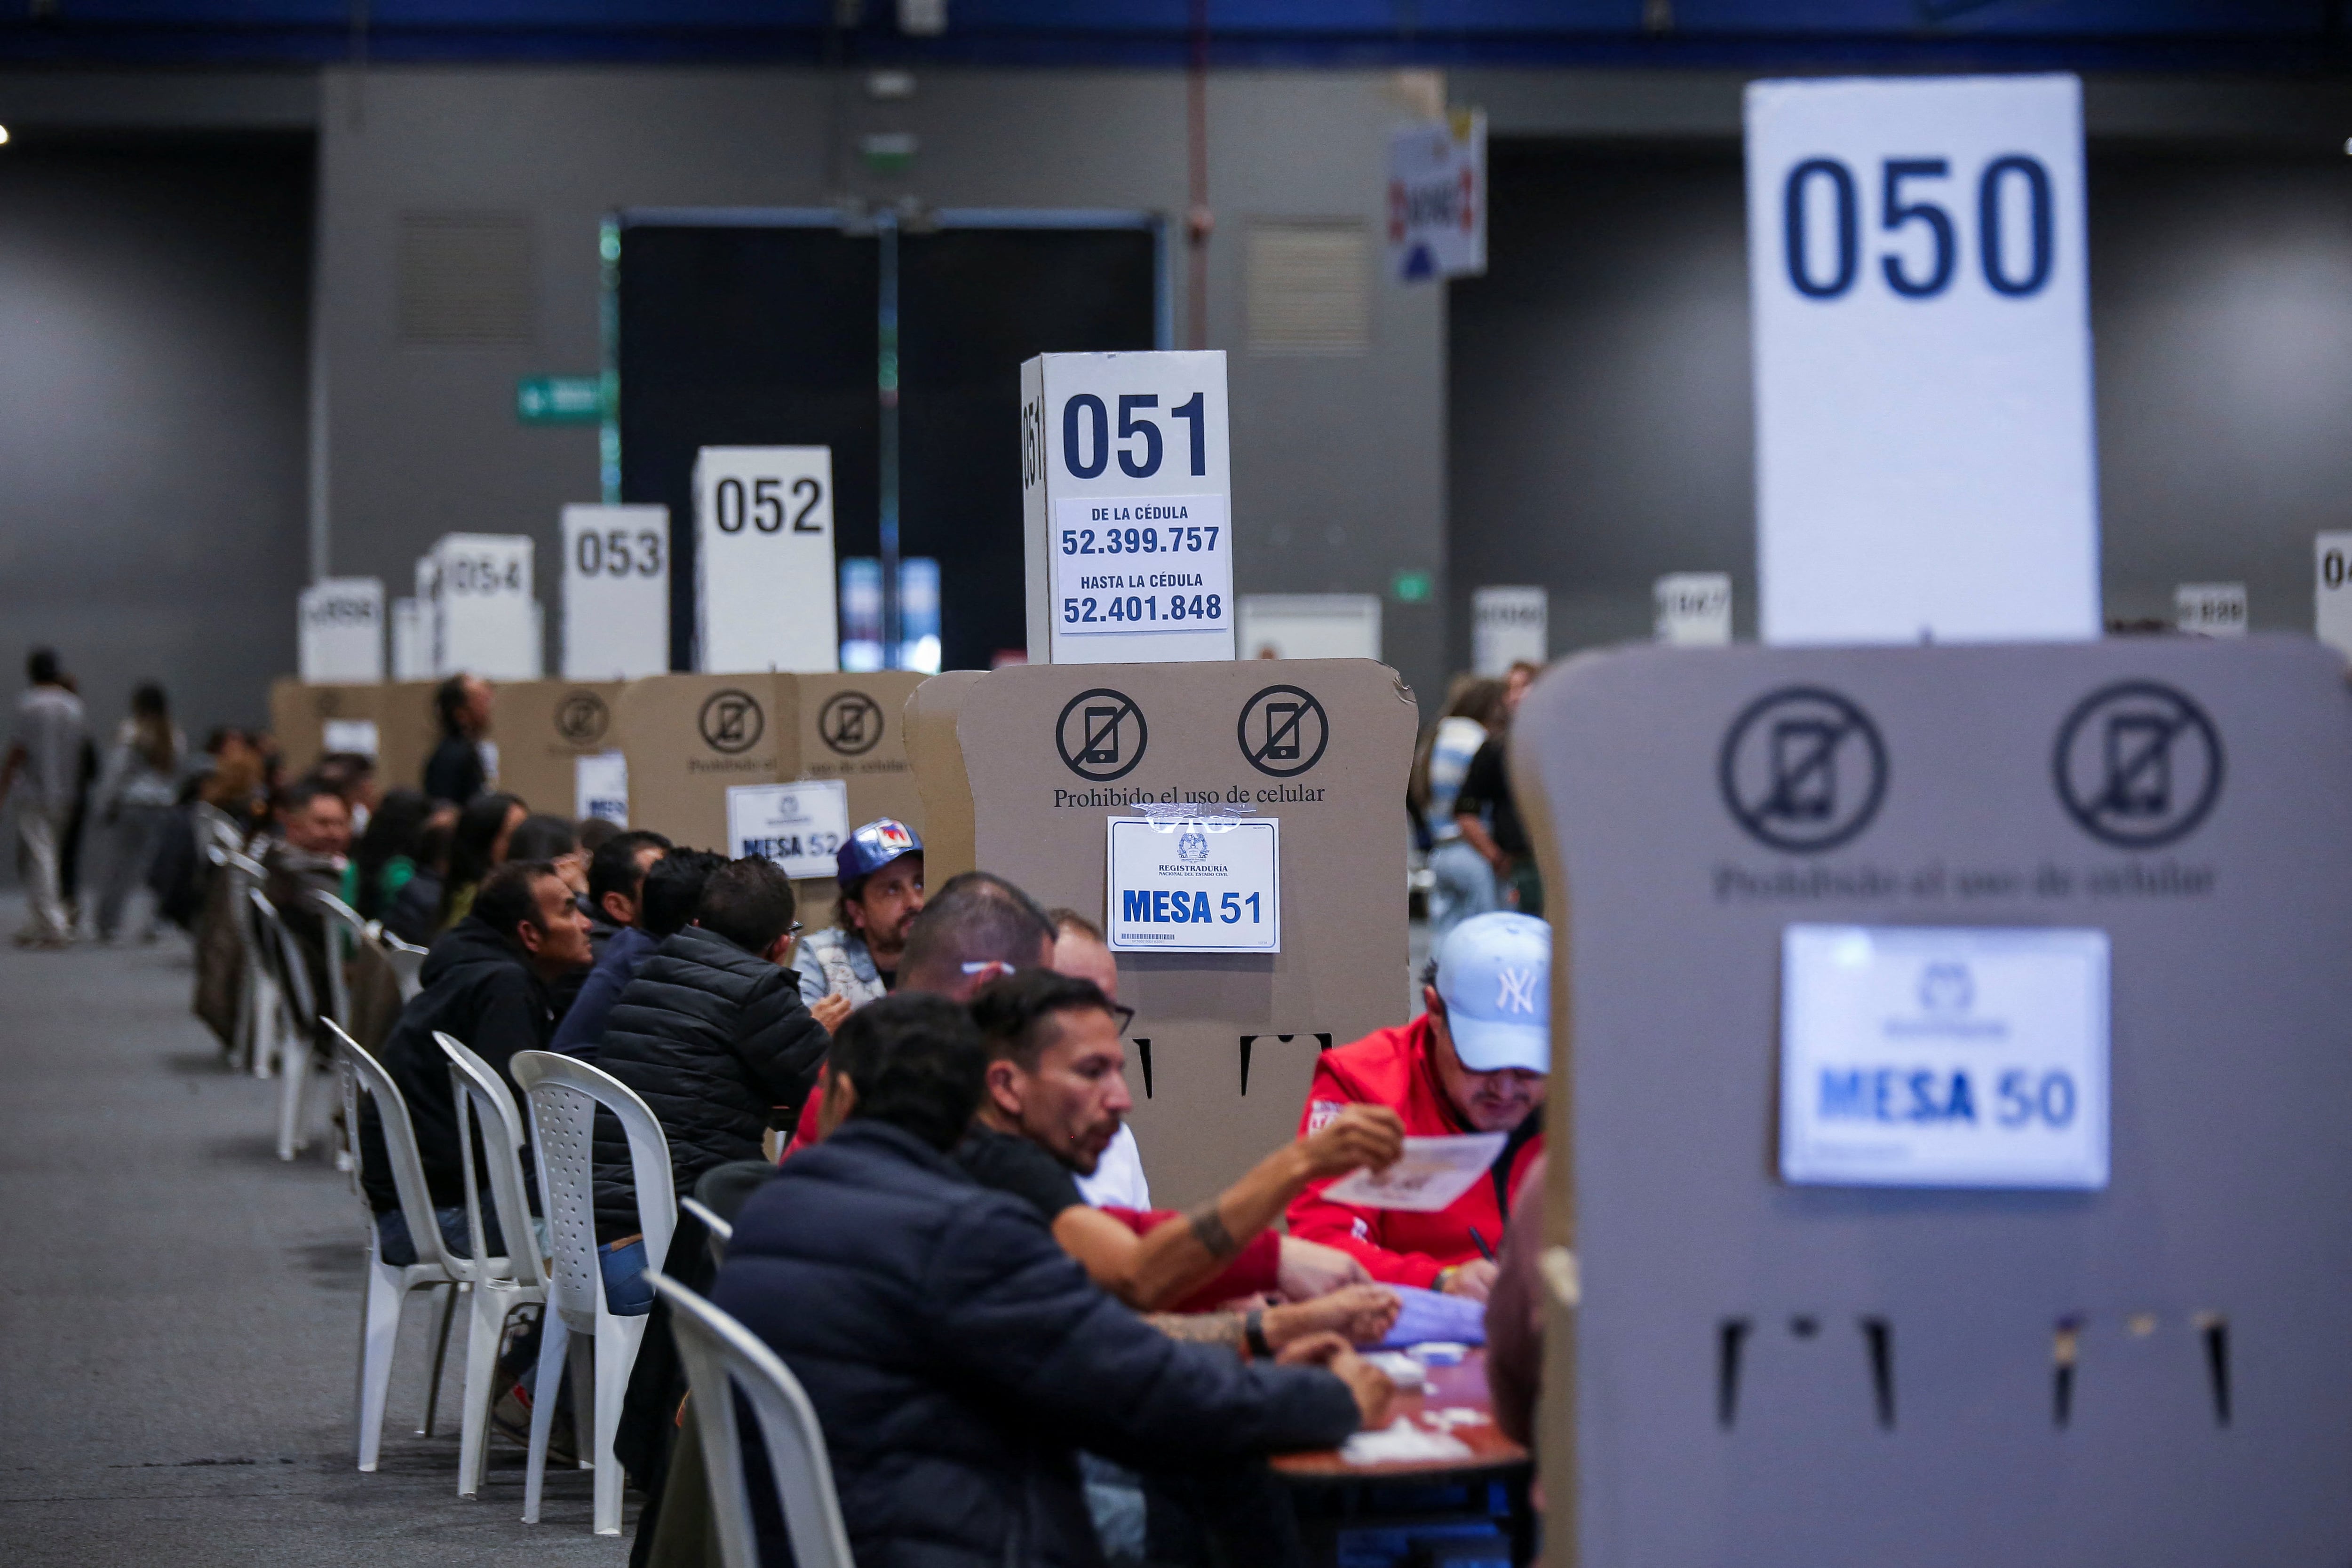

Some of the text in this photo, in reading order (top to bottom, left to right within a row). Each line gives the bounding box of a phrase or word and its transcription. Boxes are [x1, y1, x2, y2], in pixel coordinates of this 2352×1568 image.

[1786, 157, 2054, 300] 050
[1024, 396, 1041, 490] 051
[1063, 392, 1206, 479] 051
[717, 478, 822, 533] 052
[1092, 504, 1188, 521] DE LA CÉDULA
[577, 529, 660, 577] 053
[1062, 526, 1219, 555] 52.399.757
[1081, 571, 1203, 589] HASTA LA CÉDULA
[1064, 594, 1222, 623] 52.401.848
[1054, 784, 1325, 808] Prohibido el uso de celular
[810, 832, 839, 855] 52
[1159, 863, 1228, 872] REGISTRADURÍA
[1123, 889, 1260, 924] MESA 51
[1817, 1068, 2077, 1130] MESA 50
